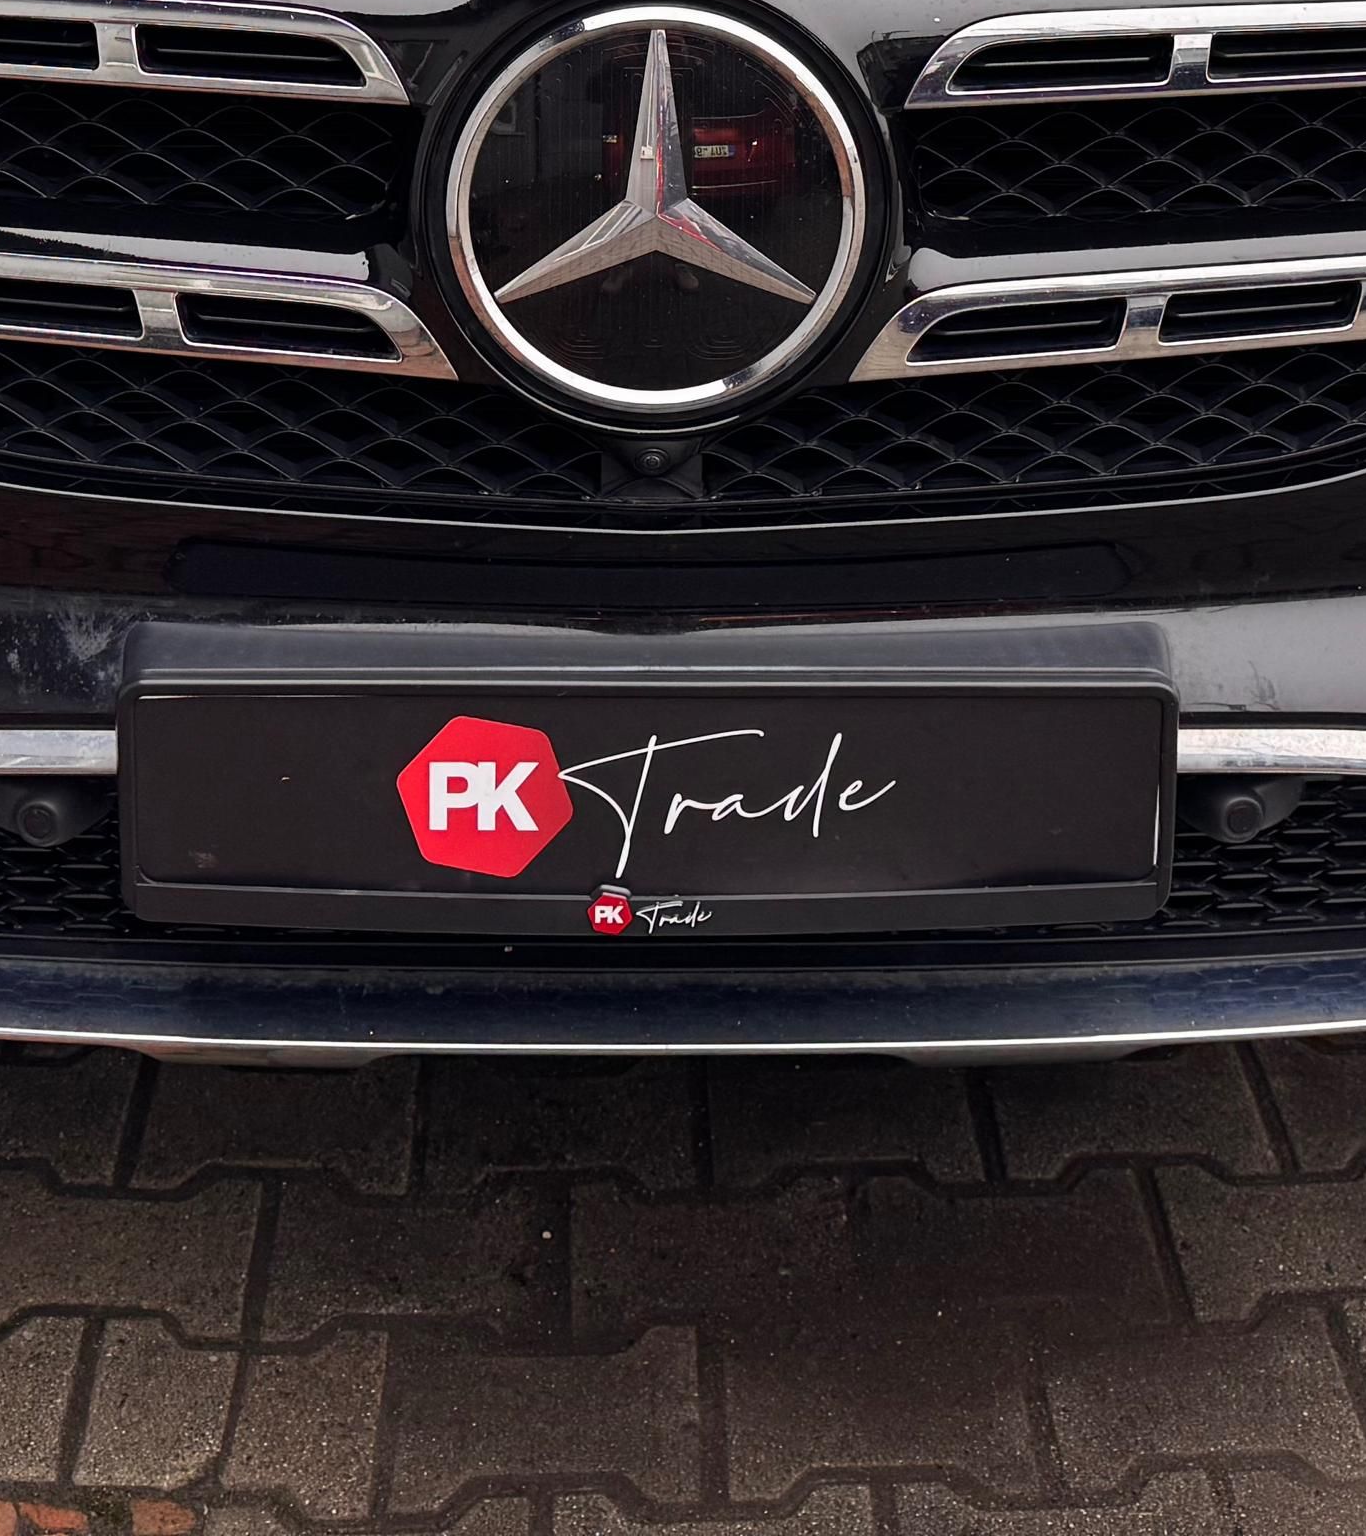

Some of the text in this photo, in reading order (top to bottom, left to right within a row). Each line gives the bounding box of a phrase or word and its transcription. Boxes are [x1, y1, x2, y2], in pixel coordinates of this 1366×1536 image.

[428, 728, 896, 880] PK Trade
[594, 900, 713, 935] PK Trade
